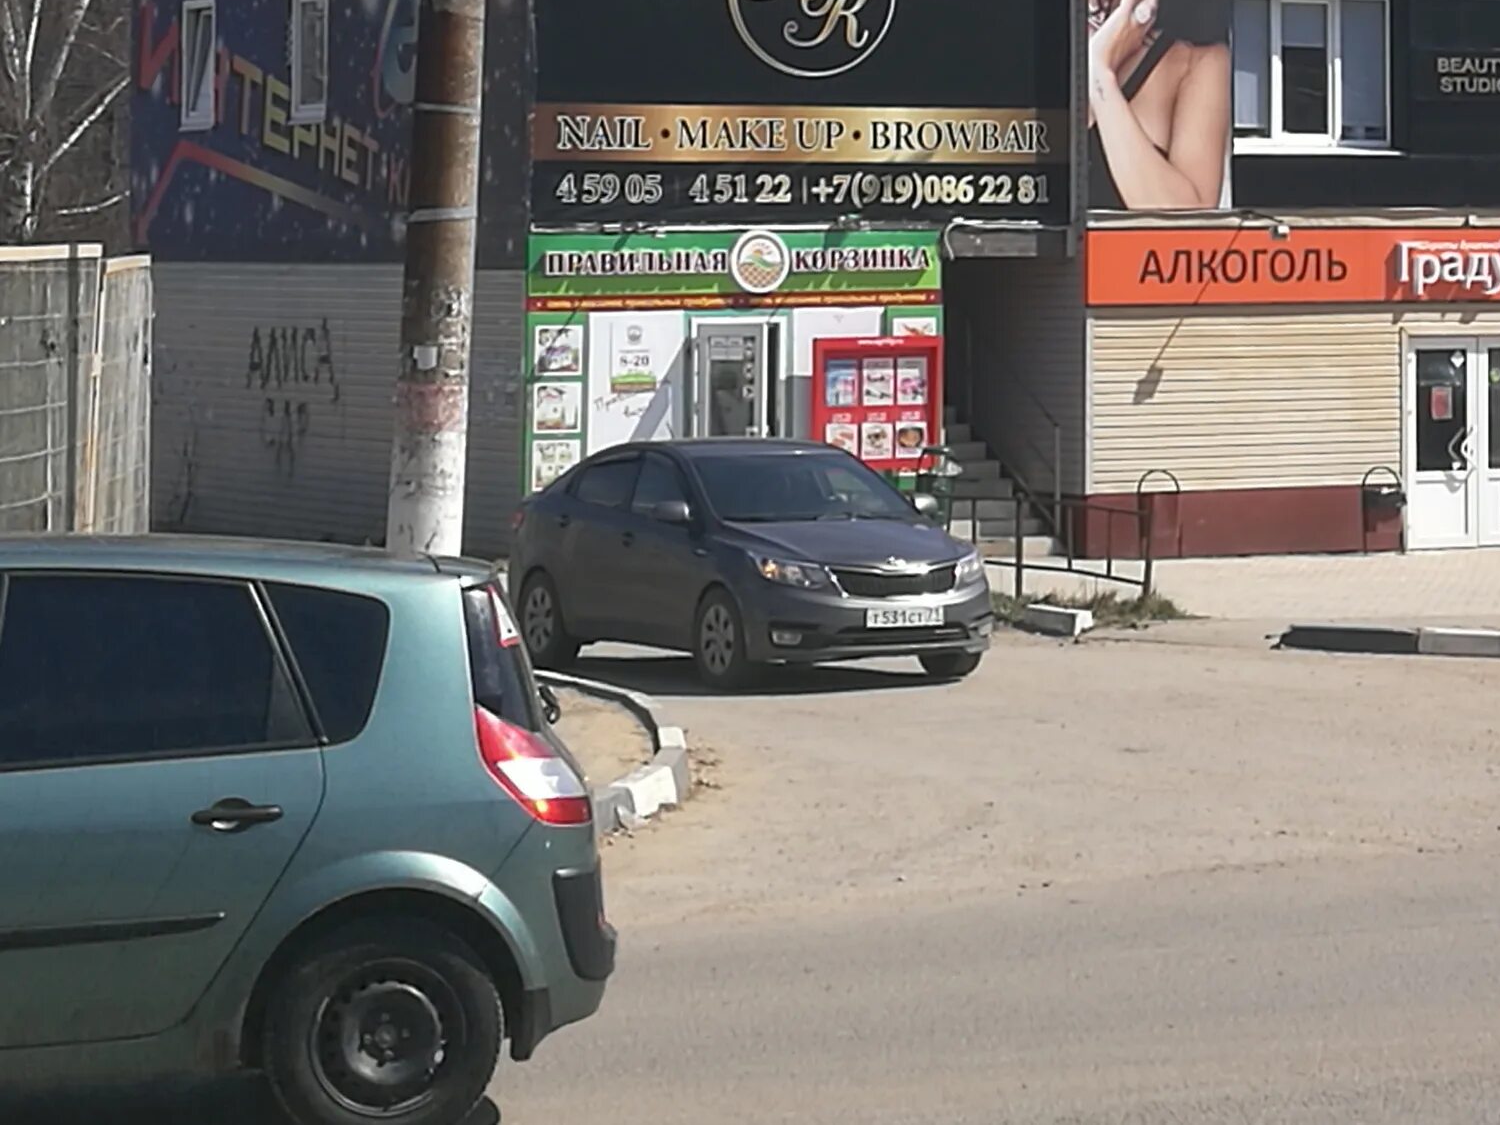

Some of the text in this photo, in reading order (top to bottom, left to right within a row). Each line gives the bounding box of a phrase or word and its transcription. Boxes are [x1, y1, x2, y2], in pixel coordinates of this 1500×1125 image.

[557, 115, 1050, 153] NAIL MAKE UP BROWBAR
[545, 247, 728, 276] ПРАВИЛЬНАЯ
[791, 246, 931, 272] КОРЗИНКА
[1139, 248, 1348, 284] АЛКОГОЛЬ
